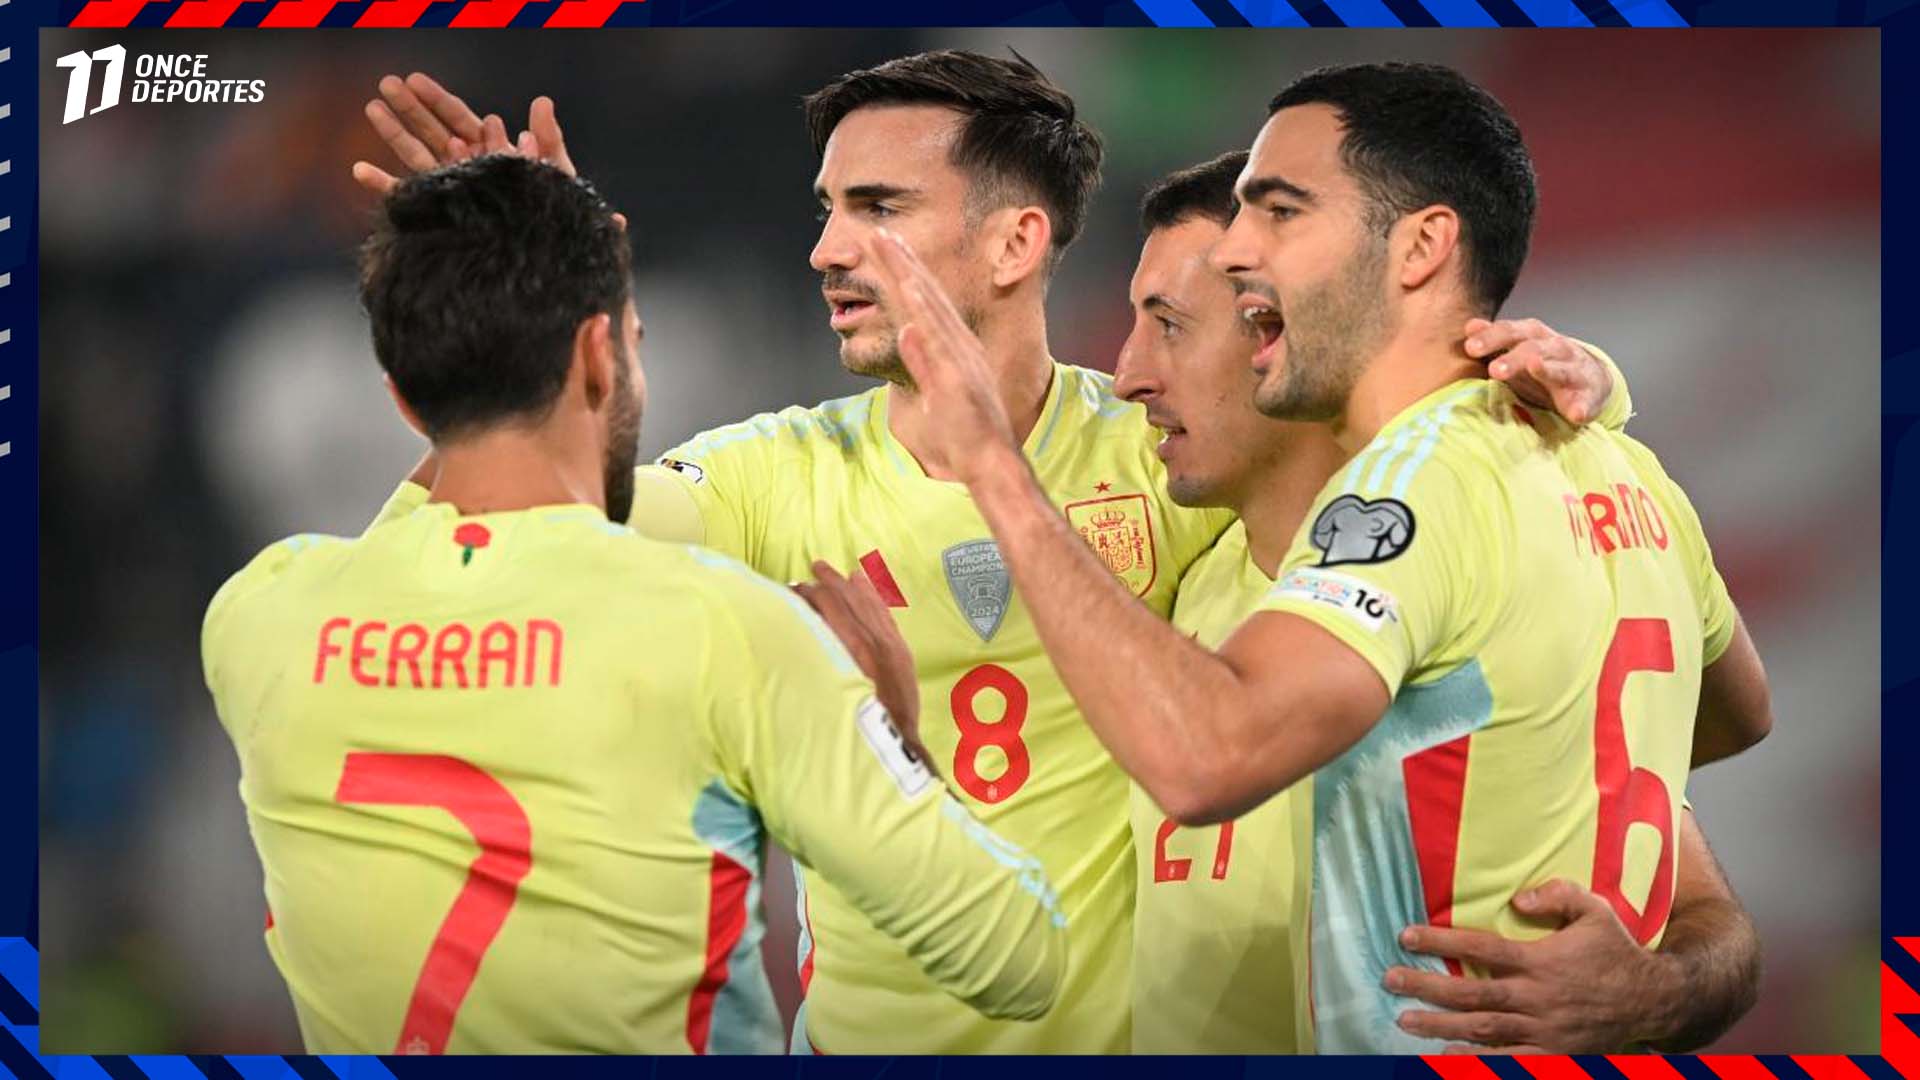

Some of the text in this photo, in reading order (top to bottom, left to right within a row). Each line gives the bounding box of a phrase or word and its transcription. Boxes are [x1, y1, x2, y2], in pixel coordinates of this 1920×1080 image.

[950, 552, 1003, 568] EUROPEA
[970, 605, 1000, 618] 2024
[313, 617, 563, 688] FERRAN
[950, 664, 1030, 805] 8
[1591, 617, 1674, 948] 6
[335, 752, 533, 1055] 7
